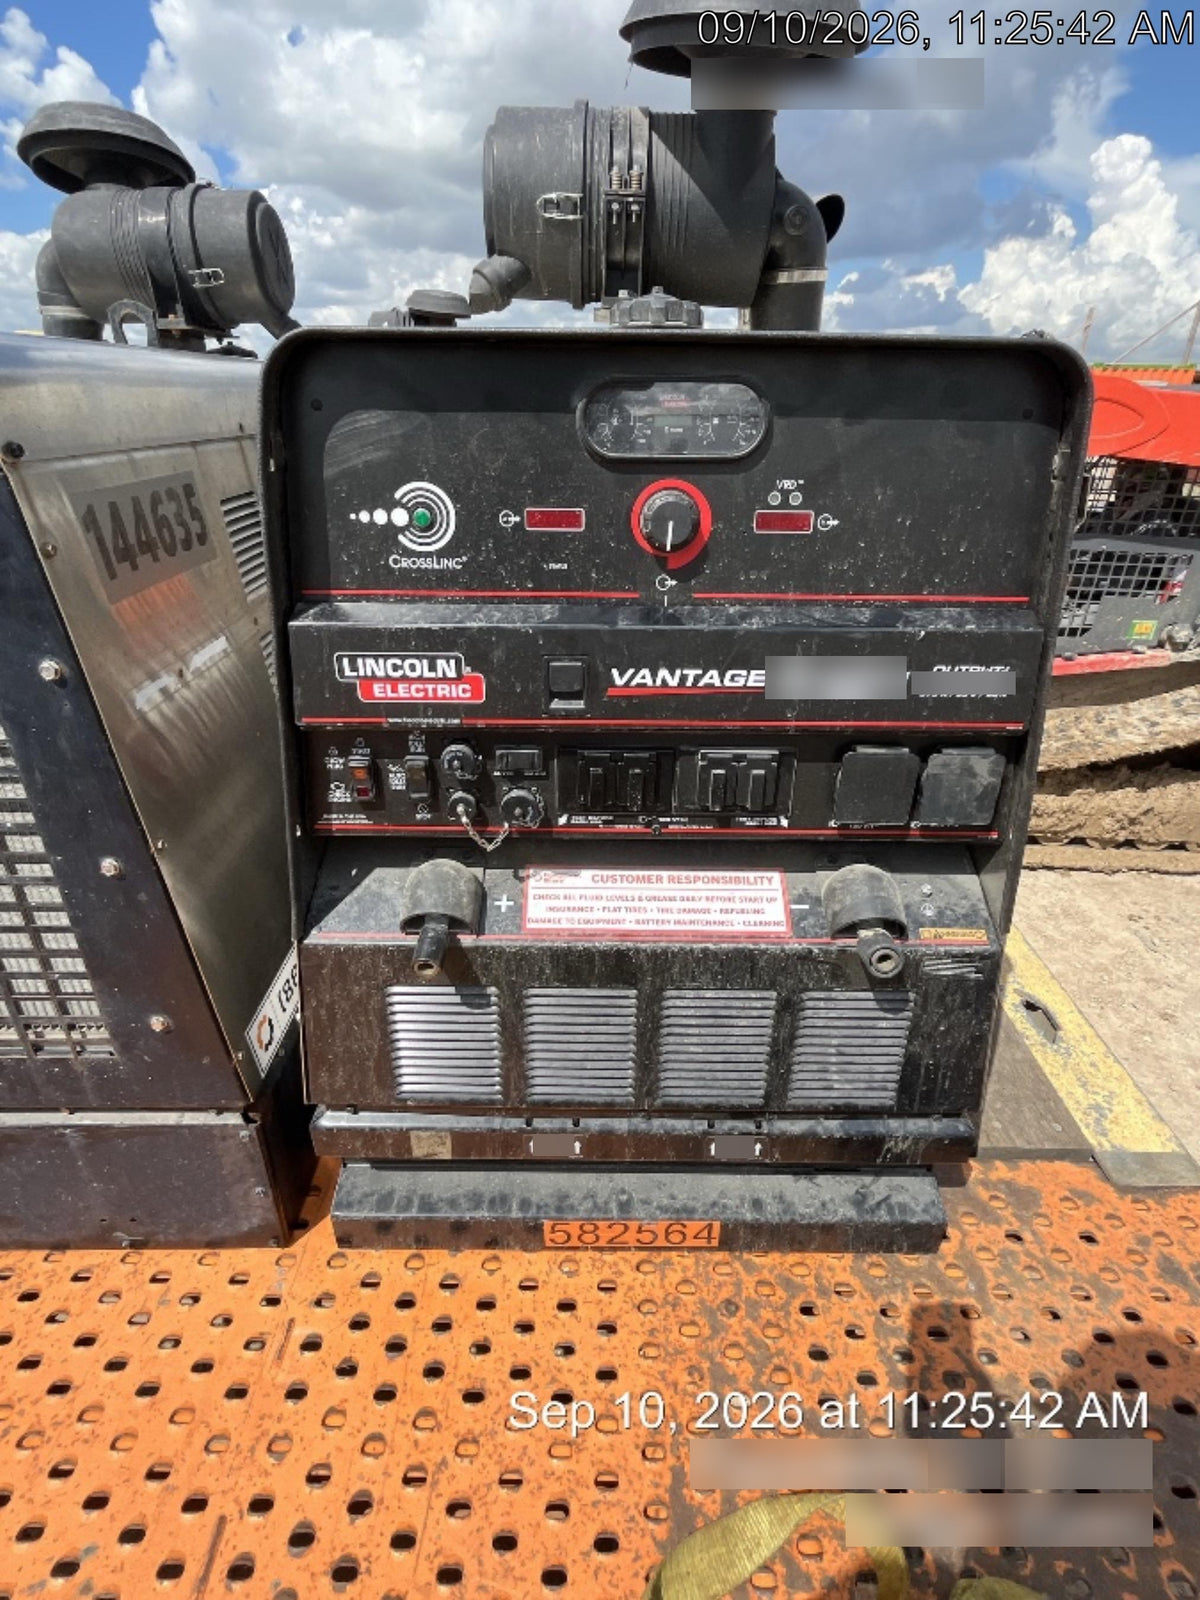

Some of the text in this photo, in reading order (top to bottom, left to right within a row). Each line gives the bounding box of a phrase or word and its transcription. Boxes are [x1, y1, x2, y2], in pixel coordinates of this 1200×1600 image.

[81, 483, 208, 580] 144635
[342, 657, 457, 678] LINCOLN
[610, 667, 766, 688] VANTAGE
[372, 684, 473, 698] ELECTRIC
[591, 874, 775, 887] CUSTOMER RESPONSIBILITY
[533, 893, 561, 901] CHECK
[605, 894, 636, 902] LEVELS
[645, 895, 678, 903] GREASE
[679, 895, 703, 903] DAILY
[738, 896, 764, 904] START
[602, 906, 622, 914] FLAT
[624, 906, 648, 914] TIRES
[676, 907, 712, 915] DAMAGE
[527, 917, 562, 925] DAMAGE
[577, 918, 627, 926] EQUIPMENT
[634, 918, 671, 926] BATTERY
[673, 918, 736, 927] MAINTENANCE
[742, 920, 786, 928] CLEANING
[549, 1222, 717, 1245] 582564
